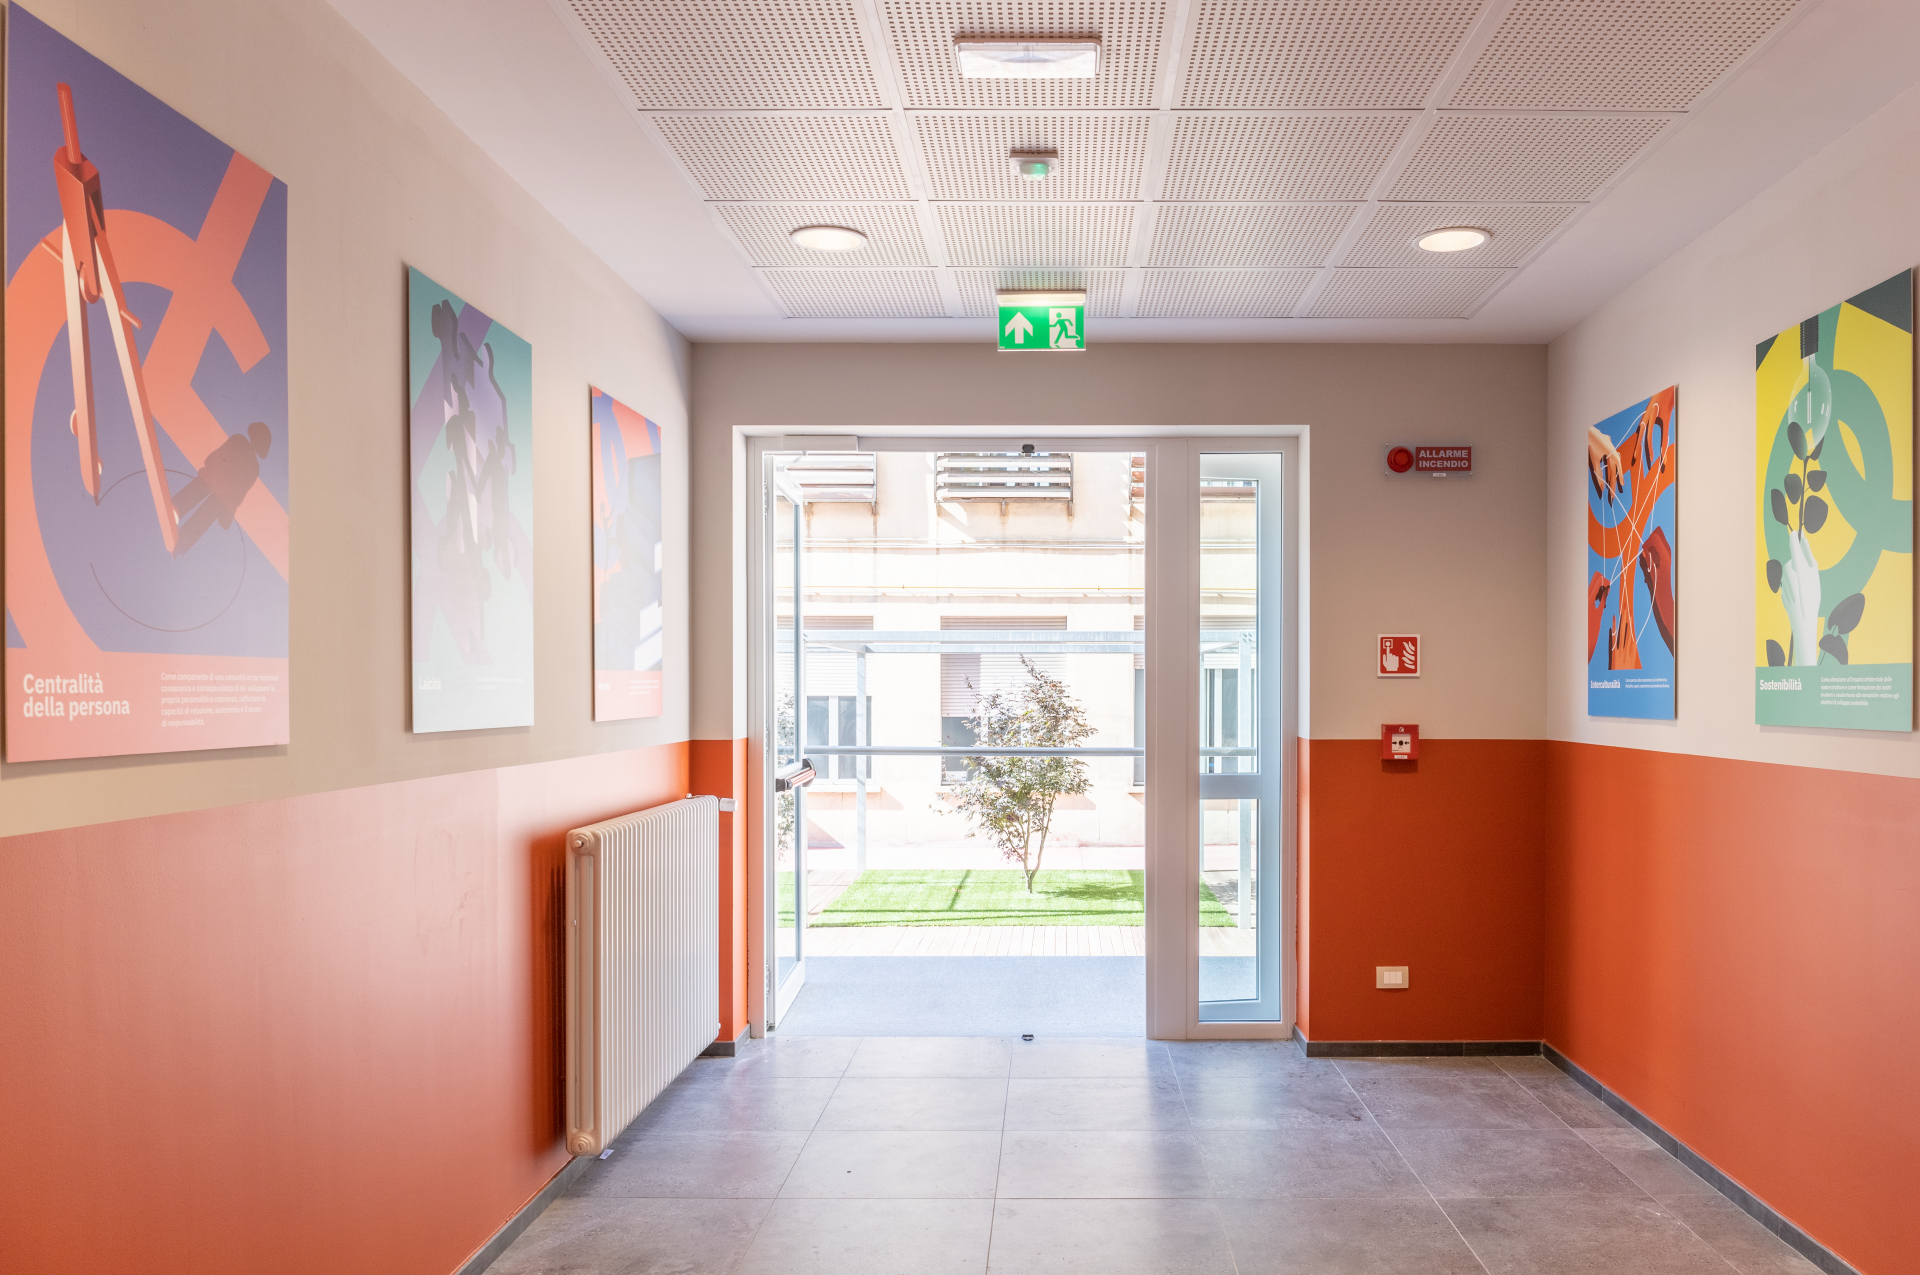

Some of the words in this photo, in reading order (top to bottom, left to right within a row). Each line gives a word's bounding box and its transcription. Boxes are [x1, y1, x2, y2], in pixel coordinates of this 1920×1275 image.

[1419, 450, 1469, 458] ALLARME
[1419, 460, 1469, 468] INCENDIO
[160, 672, 176, 681] Come
[177, 673, 208, 682] componente
[225, 673, 246, 681] comunità
[23, 672, 103, 694] Centralità
[197, 684, 234, 693] consapevolezza
[419, 676, 442, 690] Laicità
[1759, 678, 1802, 690] Sostenibilità
[161, 695, 180, 705] propria
[181, 695, 210, 705] personalità
[23, 696, 64, 717] della
[69, 700, 130, 721] persona
[161, 707, 184, 717] capacità
[215, 705, 240, 714] autonomia
